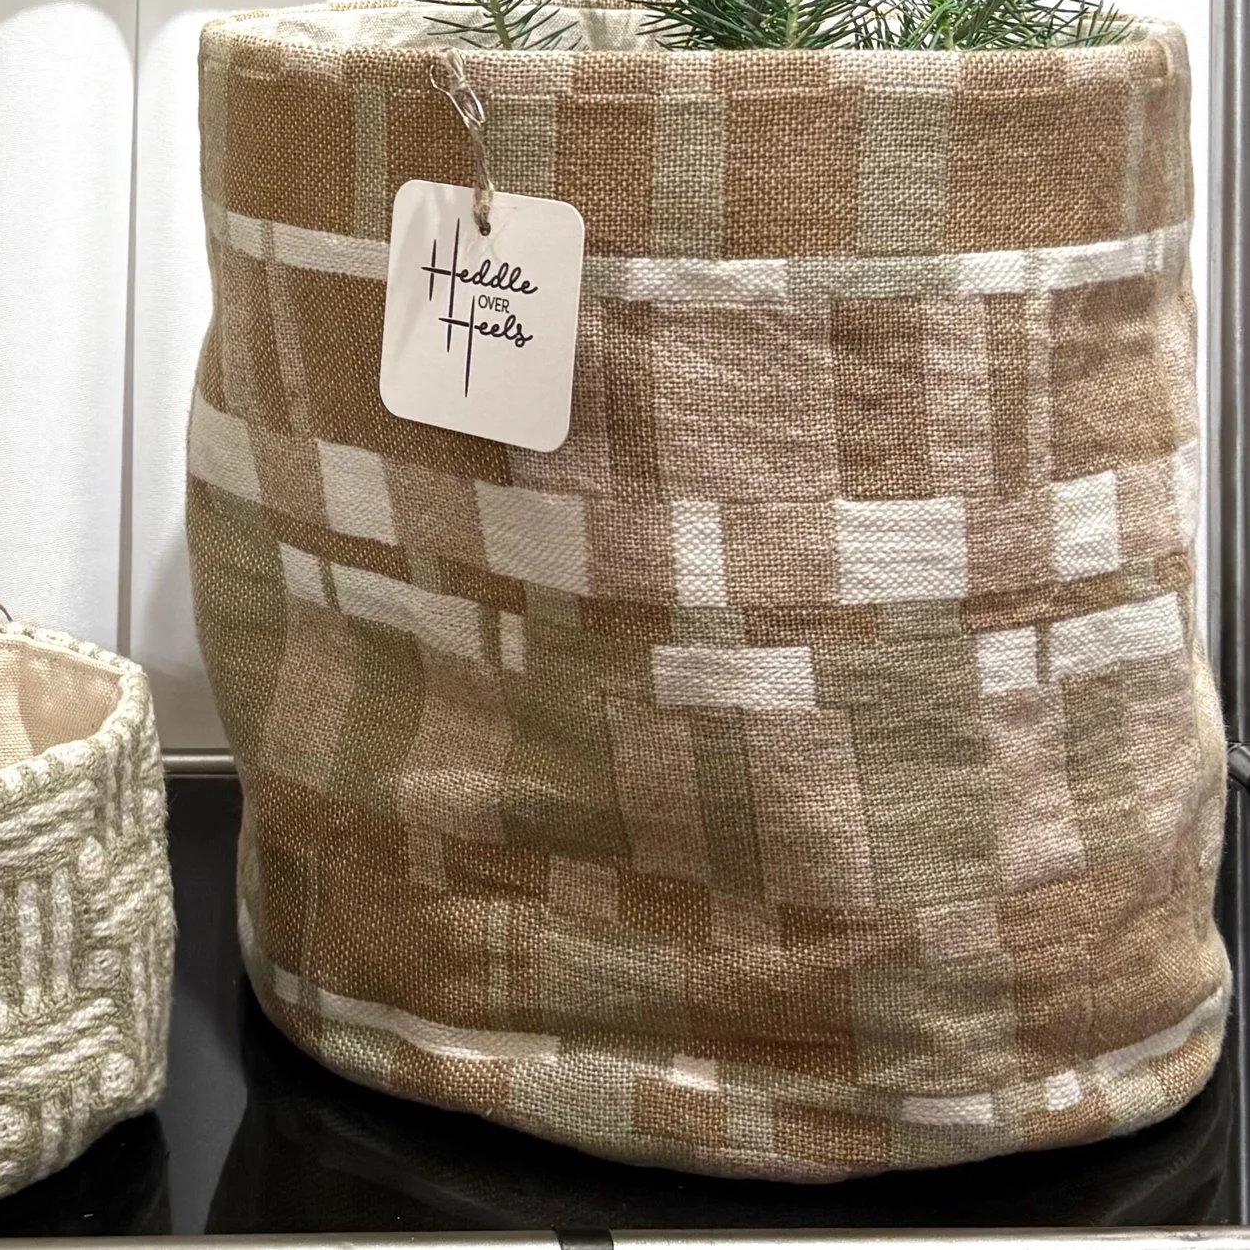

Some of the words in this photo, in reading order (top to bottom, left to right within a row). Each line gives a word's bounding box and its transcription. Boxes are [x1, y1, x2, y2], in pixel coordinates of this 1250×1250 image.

[421, 218, 538, 352] Heddle
[477, 293, 510, 314] OVER
[438, 295, 533, 398] Heels
